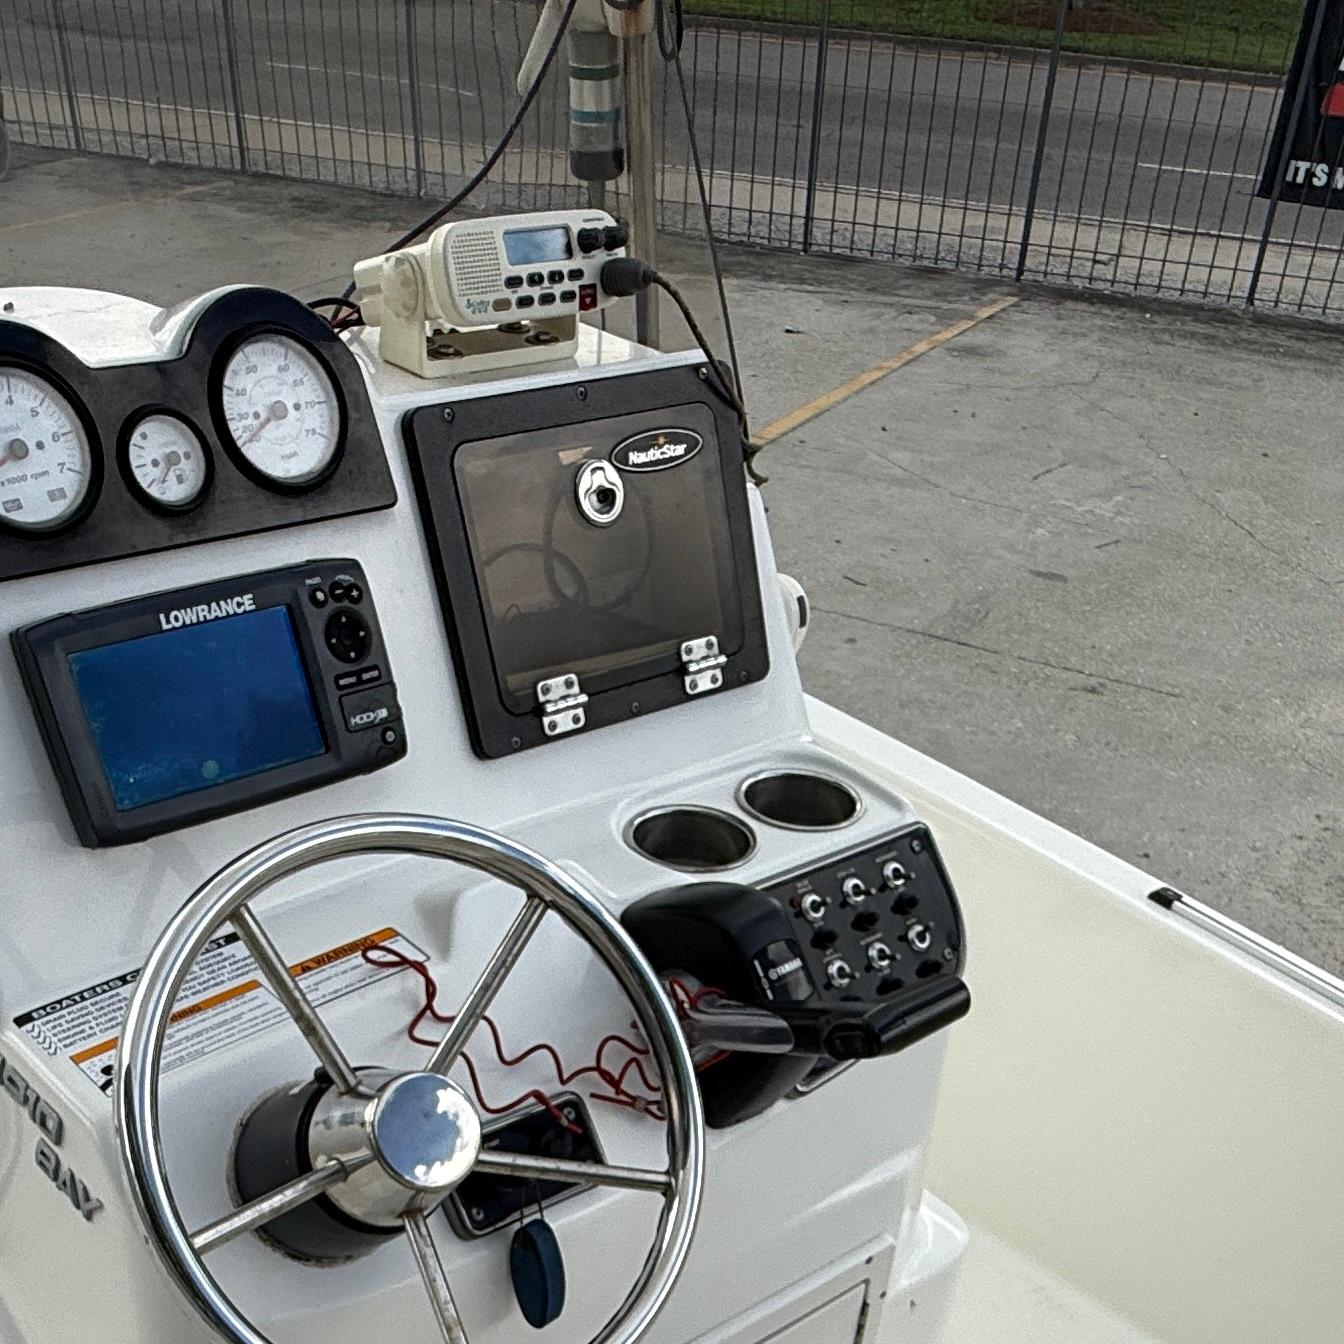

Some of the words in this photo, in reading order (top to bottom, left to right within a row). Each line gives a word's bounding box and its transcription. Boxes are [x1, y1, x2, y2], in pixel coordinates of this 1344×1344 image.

[1285, 160, 1329, 187] IT'S
[628, 442, 688, 466] NauticStar
[31, 470, 49, 481] rpm
[159, 593, 256, 631] LOWRANCE
[316, 937, 375, 966] WARNING
[31, 979, 123, 1020] BOATERS
[35, 1137, 104, 1222] BAY
